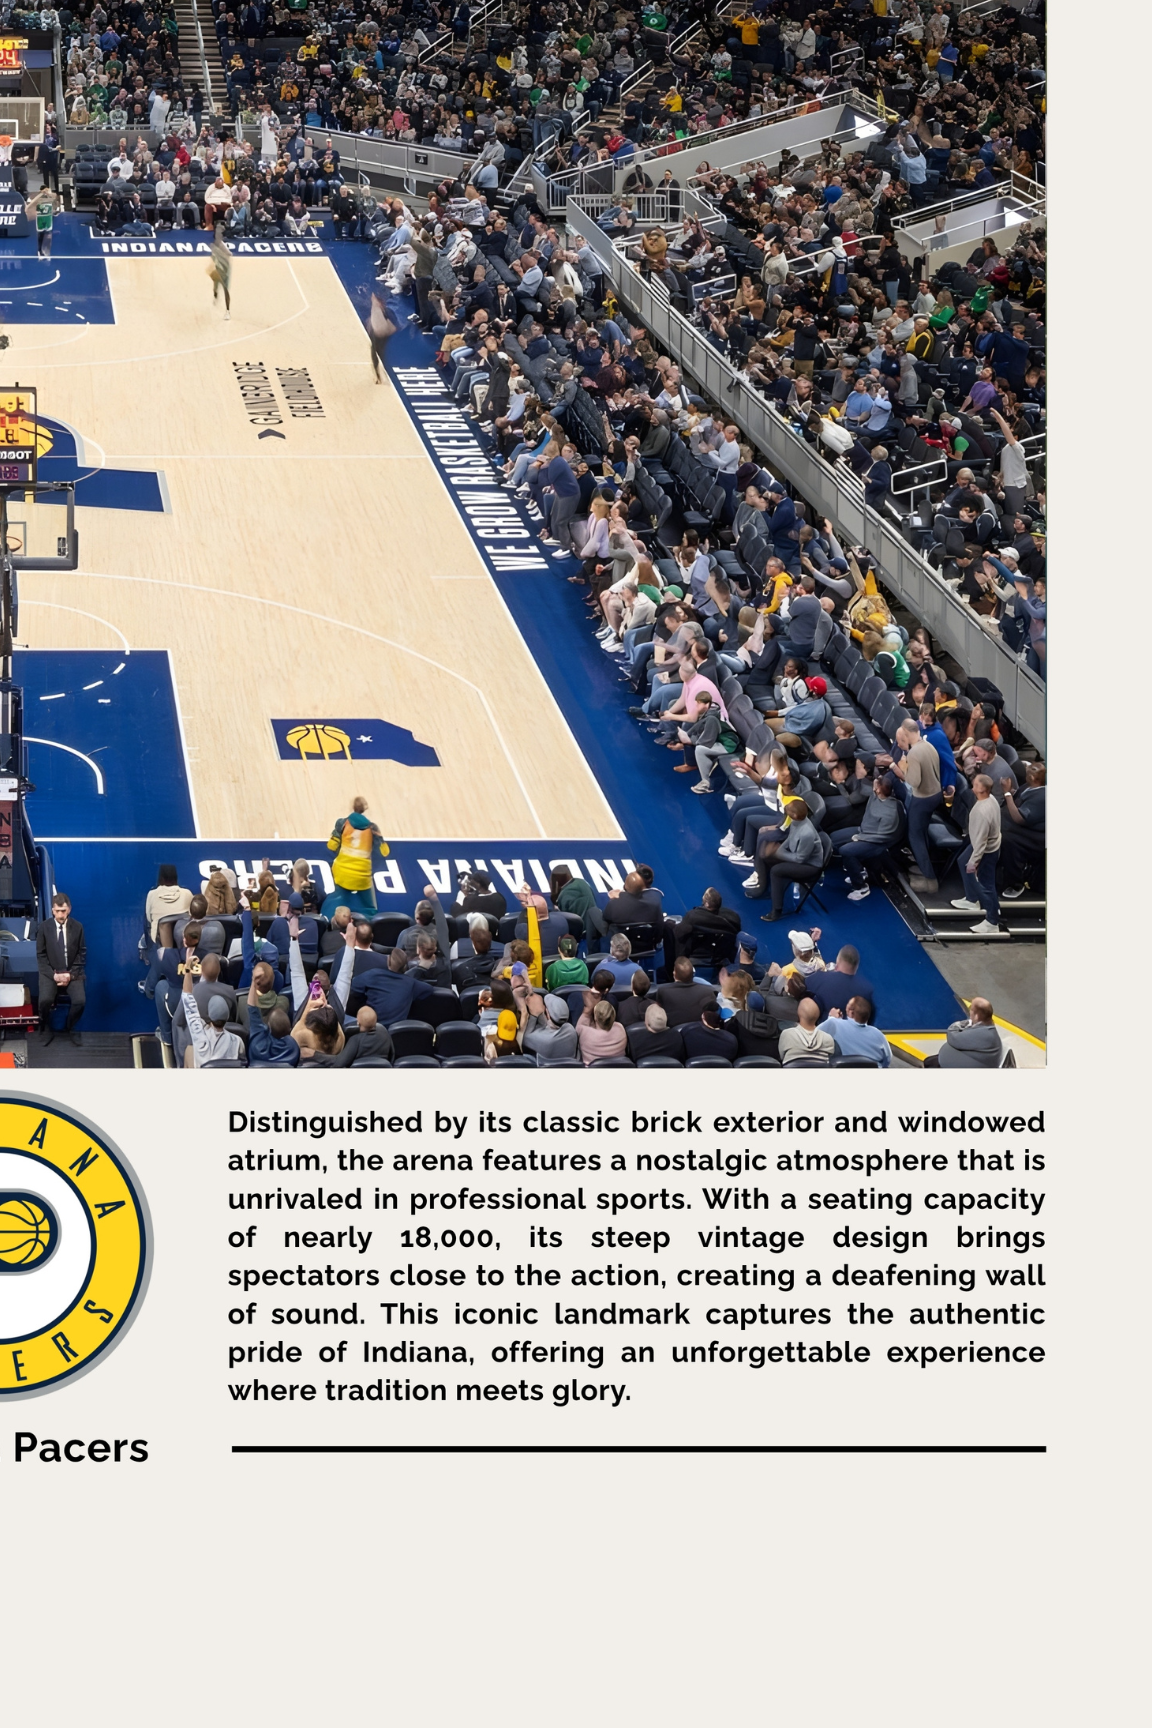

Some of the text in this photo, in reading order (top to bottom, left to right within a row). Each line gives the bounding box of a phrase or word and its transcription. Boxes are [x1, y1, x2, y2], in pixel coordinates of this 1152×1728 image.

[101, 242, 214, 253] INDIANA
[391, 366, 550, 572] WE GROW BASKETBALL HERE
